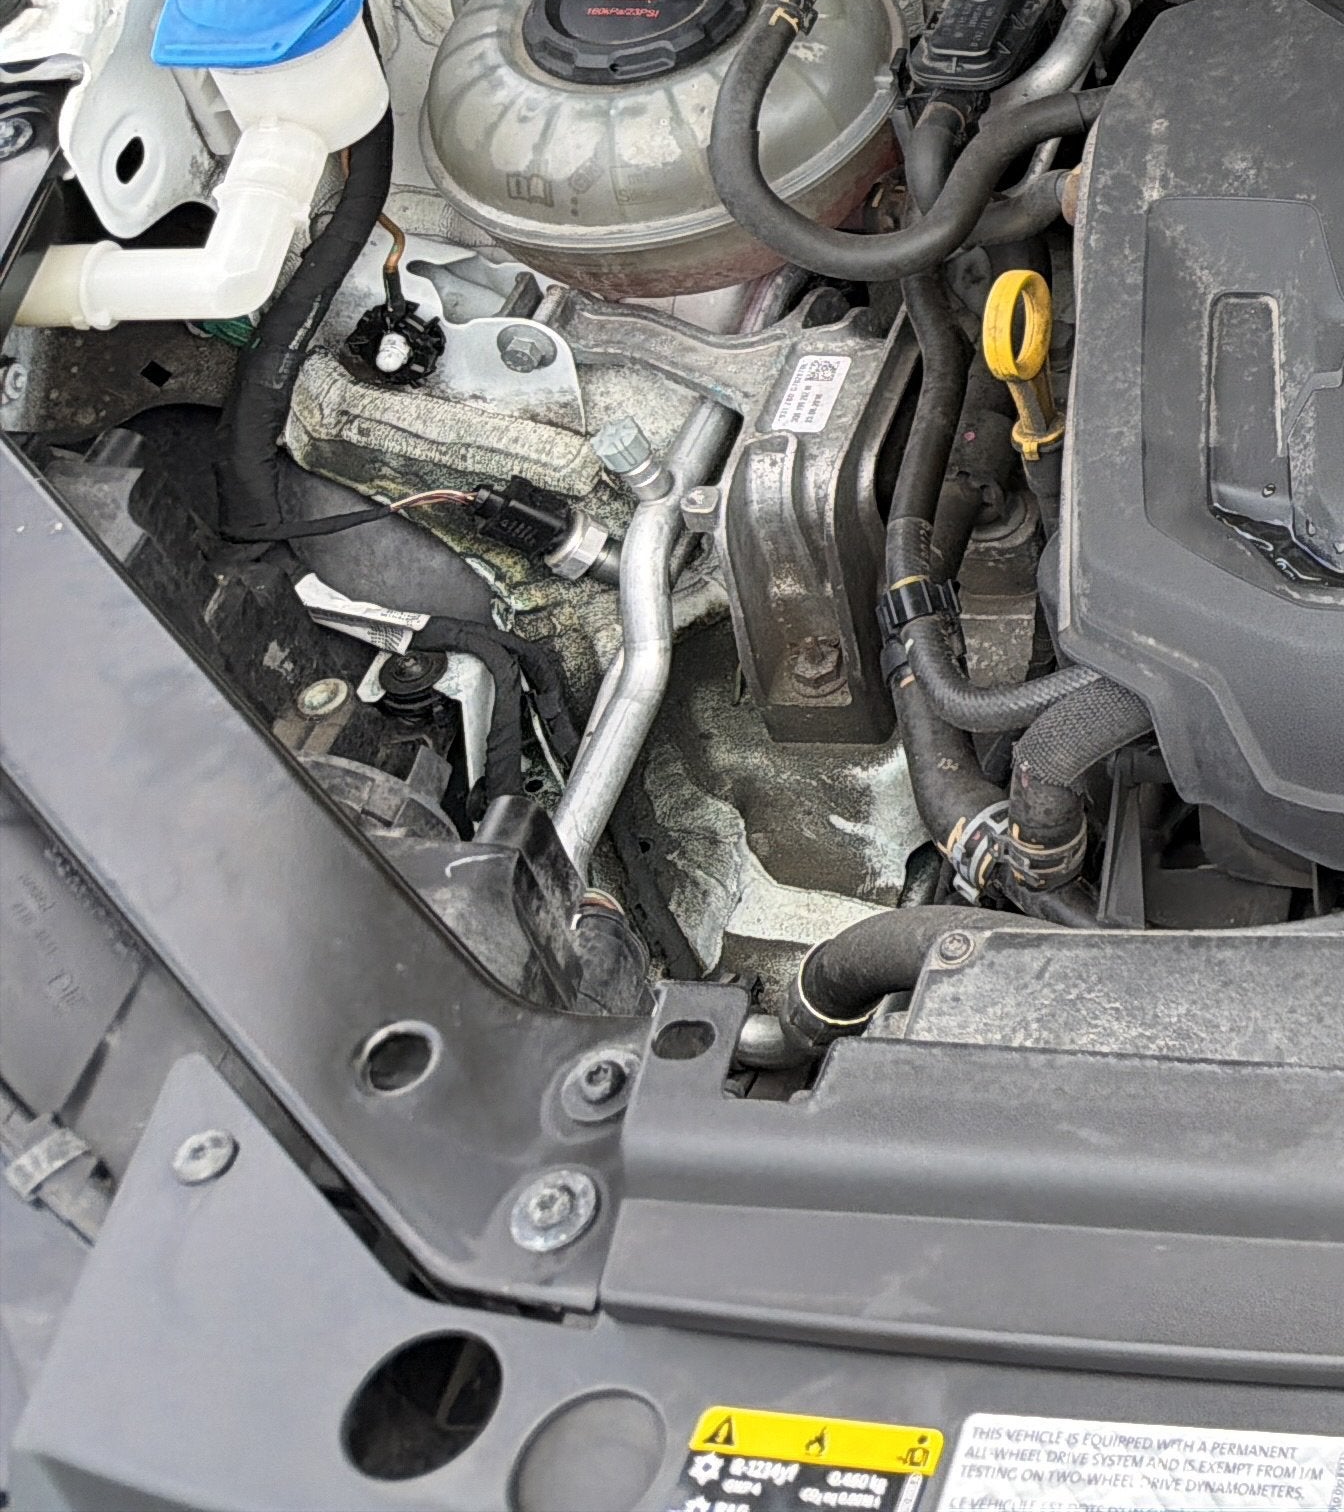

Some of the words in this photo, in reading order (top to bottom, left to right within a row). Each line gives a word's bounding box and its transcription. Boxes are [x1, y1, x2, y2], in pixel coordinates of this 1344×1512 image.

[972, 1426, 1002, 1440] THIS
[1006, 1428, 1063, 1446] VEHICLE
[1066, 1432, 1079, 1445] IS
[1082, 1432, 1154, 1451] EQUIPPED
[1156, 1438, 1194, 1452] WITH
[1197, 1440, 1207, 1452] A
[1209, 1441, 1298, 1460] PERMANENT
[960, 1463, 1018, 1481] TESTING
[1020, 1468, 1044, 1483] ON
[1048, 1469, 1134, 1488] TWO-WHEEL
[1140, 1475, 1183, 1491] DRIVE
[1045, 1449, 1089, 1466] DRIVE
[1092, 1453, 1145, 1468] SYSTEM
[1146, 1455, 1180, 1472] AND
[1183, 1458, 1196, 1471] IS
[1198, 1460, 1253, 1476] EXEMPT
[1256, 1464, 1296, 1479] FROM
[868, 1475, 889, 1494] kg
